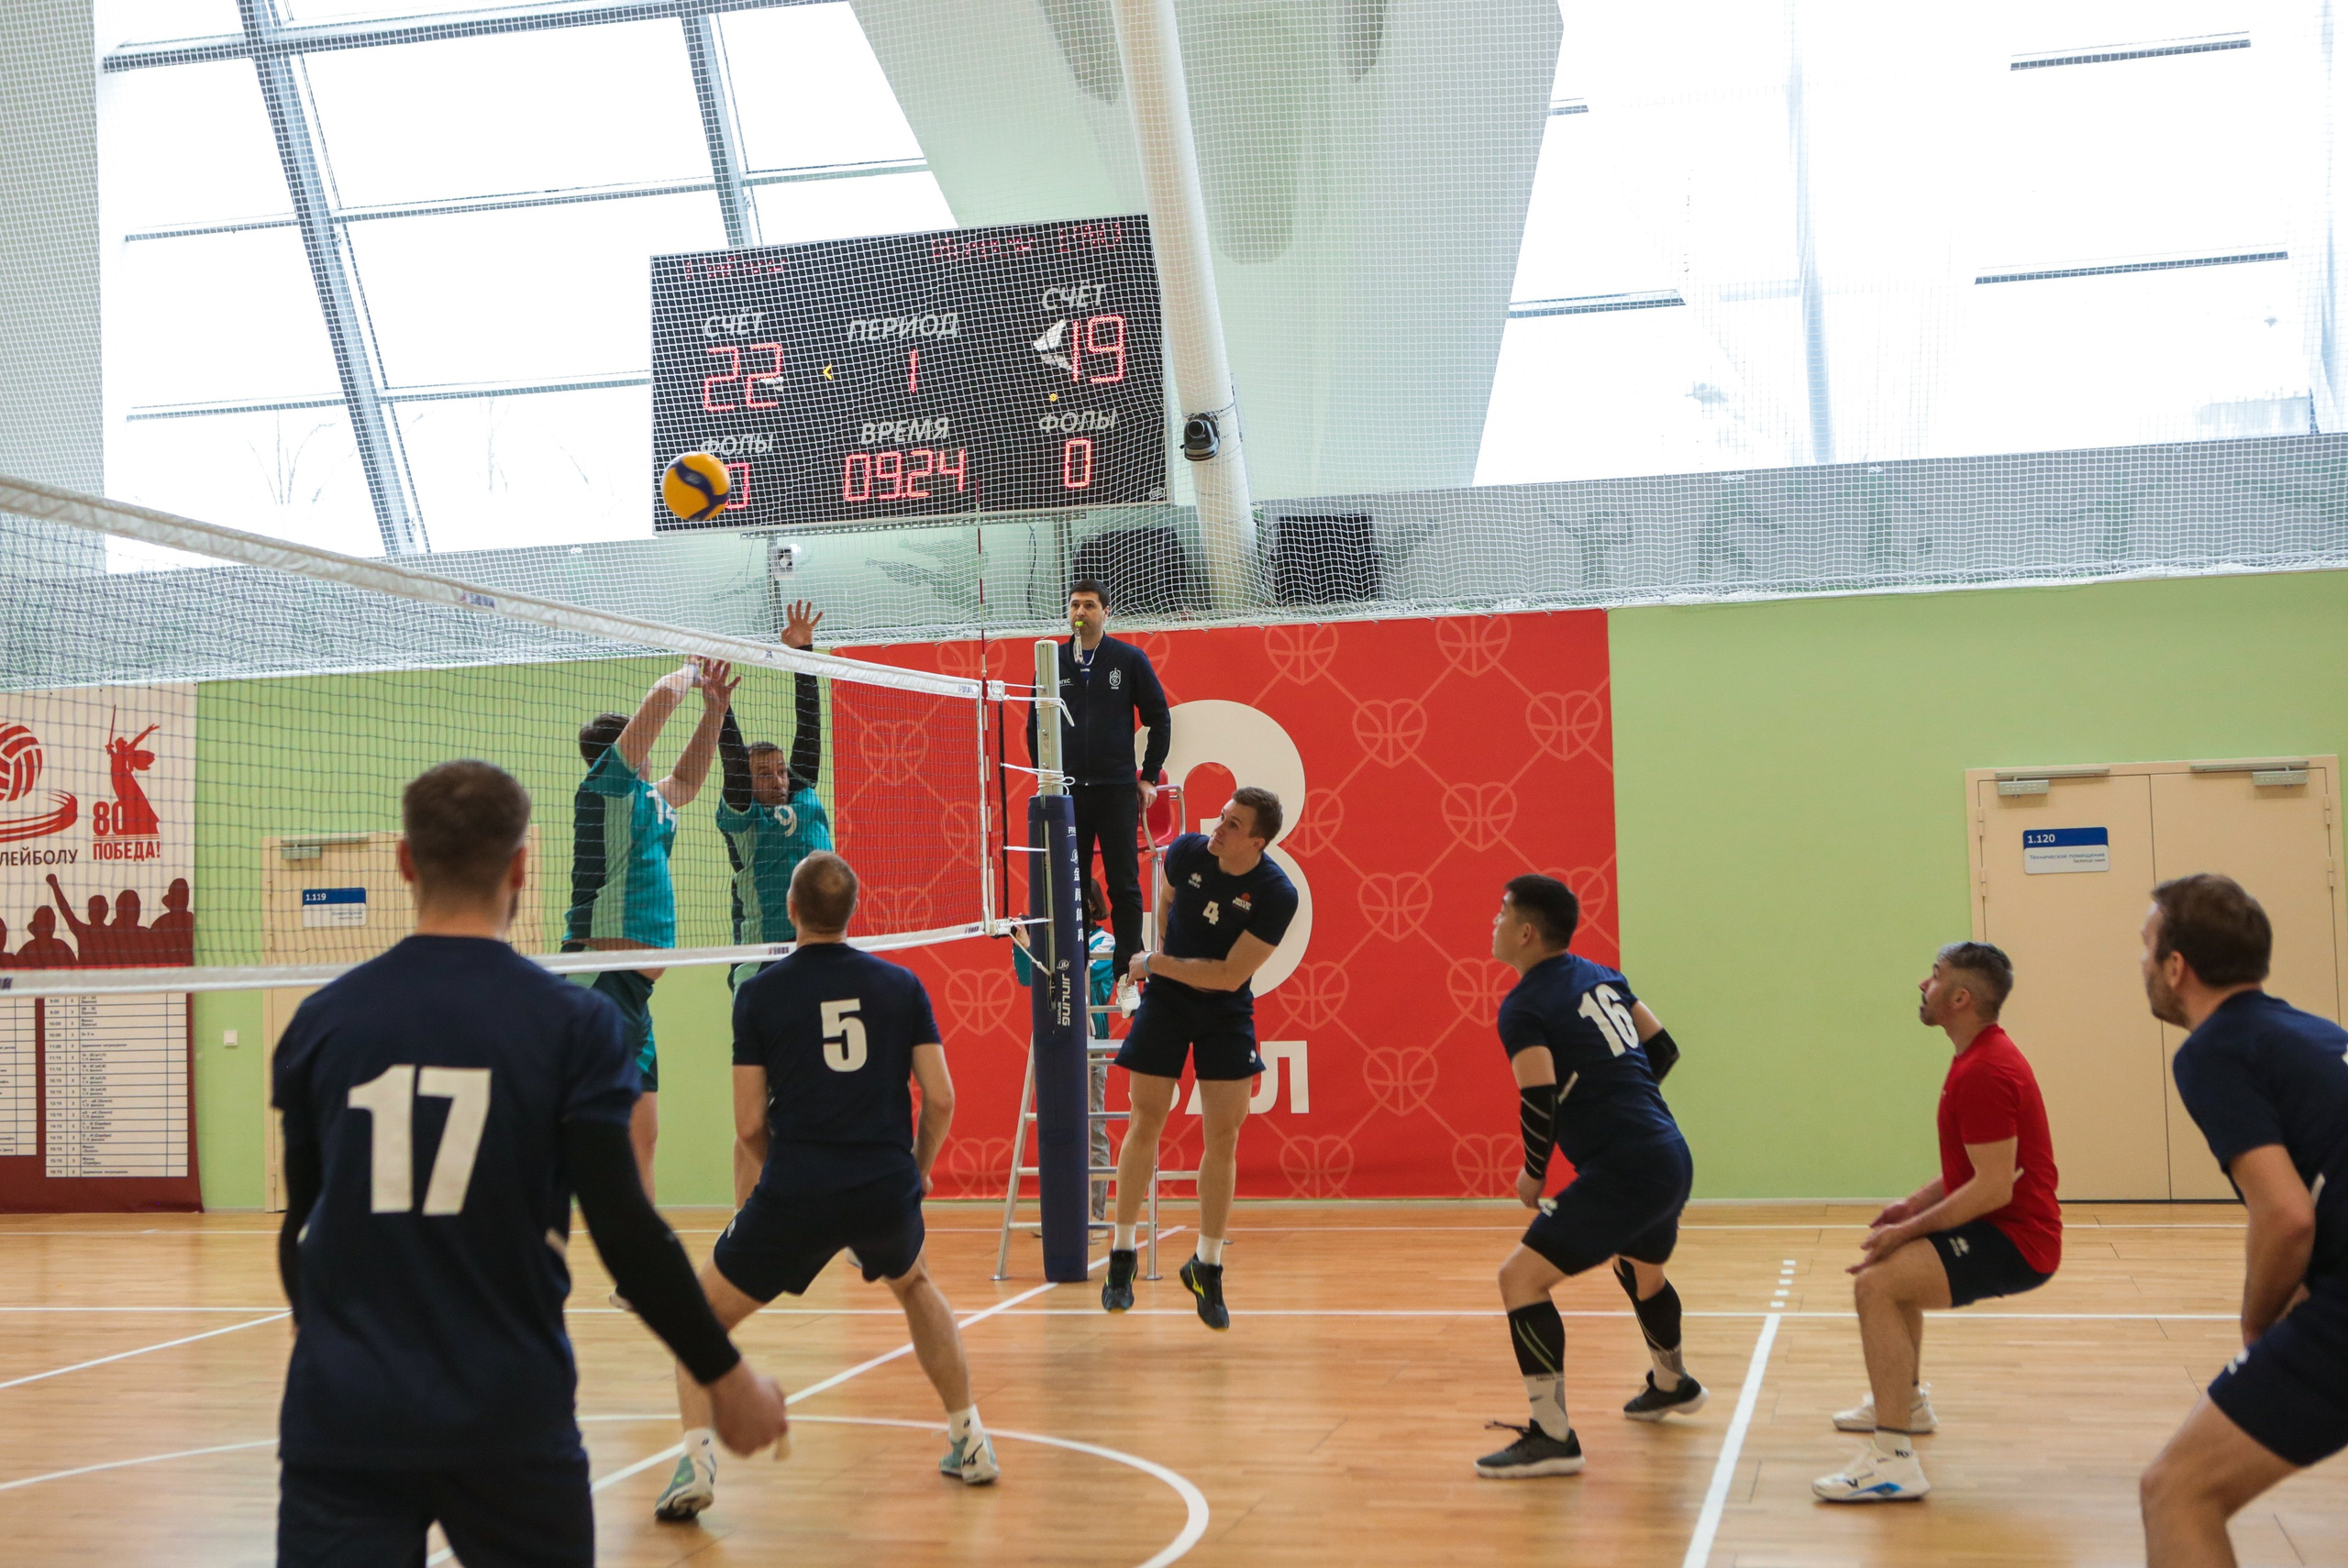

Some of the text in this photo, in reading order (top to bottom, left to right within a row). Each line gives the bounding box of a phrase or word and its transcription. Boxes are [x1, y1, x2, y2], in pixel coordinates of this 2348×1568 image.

[1042, 280, 1107, 310] СЧЁТ
[704, 307, 766, 337] СЧЁТ
[848, 313, 958, 341] ПЕРИОД
[1072, 315, 1124, 382] 19
[703, 342, 782, 411] 22
[910, 348, 916, 392] 1
[861, 417, 949, 445] ВРЕМЯ
[1038, 409, 1116, 433] ФОЛЫ
[700, 432, 773, 455] ФОЛЫ
[1064, 438, 1091, 488] 0
[93, 801, 128, 836] 80
[774, 804, 798, 837] 9
[93, 840, 161, 862] ПОБЕДА!
[2027, 834, 2055, 844] 1.120
[0, 846, 78, 867] ЛЕЙБОЛУ
[305, 892, 327, 901] 1.119
[1202, 900, 1219, 925] 4
[1061, 973, 1071, 1026] JINLING
[820, 998, 868, 1072] 5
[1577, 983, 1640, 1058] 16
[348, 1064, 492, 1216] 17
